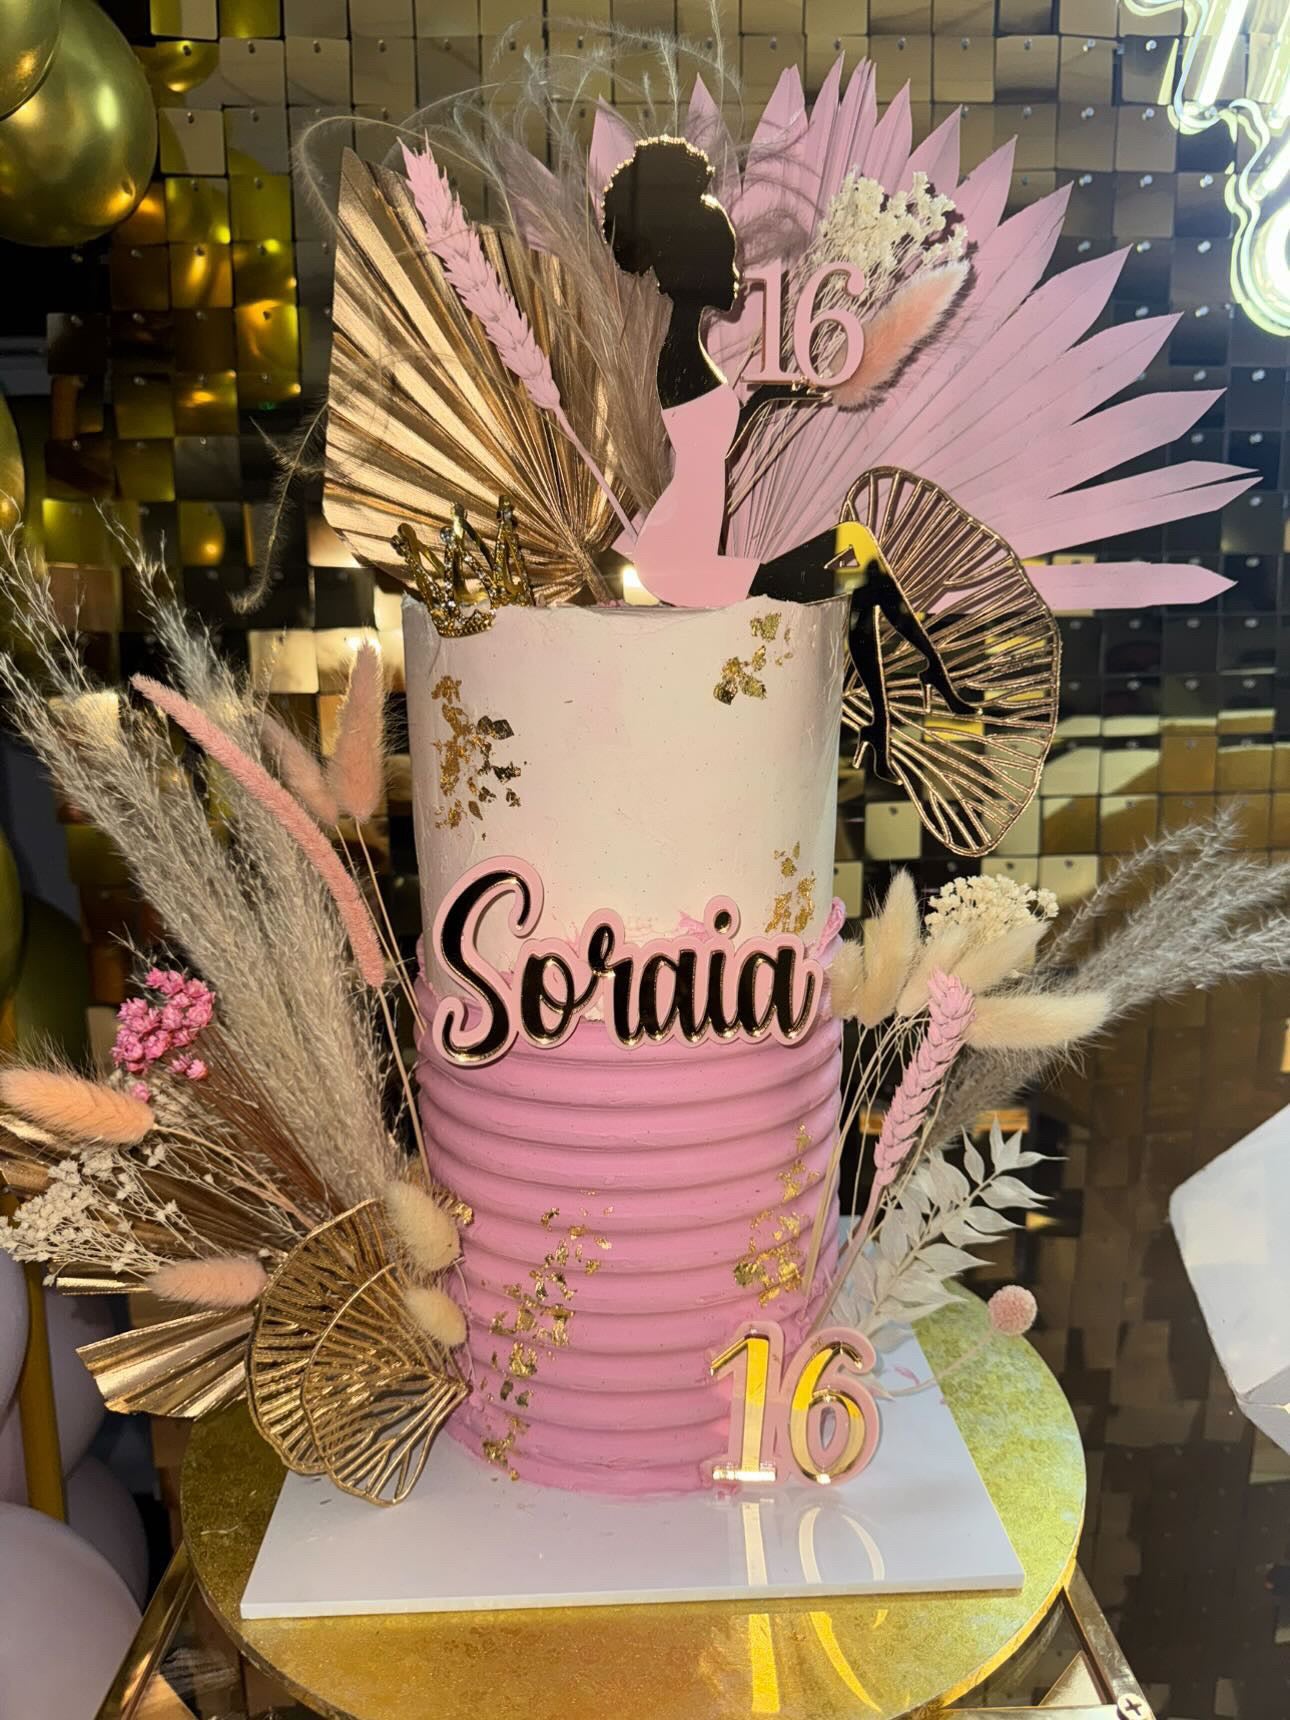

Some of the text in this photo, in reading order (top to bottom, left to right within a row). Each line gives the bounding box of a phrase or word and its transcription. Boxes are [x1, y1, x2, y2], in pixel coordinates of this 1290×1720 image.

[742, 258, 865, 388] 16
[439, 866, 817, 1063] Soraia
[709, 1334, 867, 1485] 16
